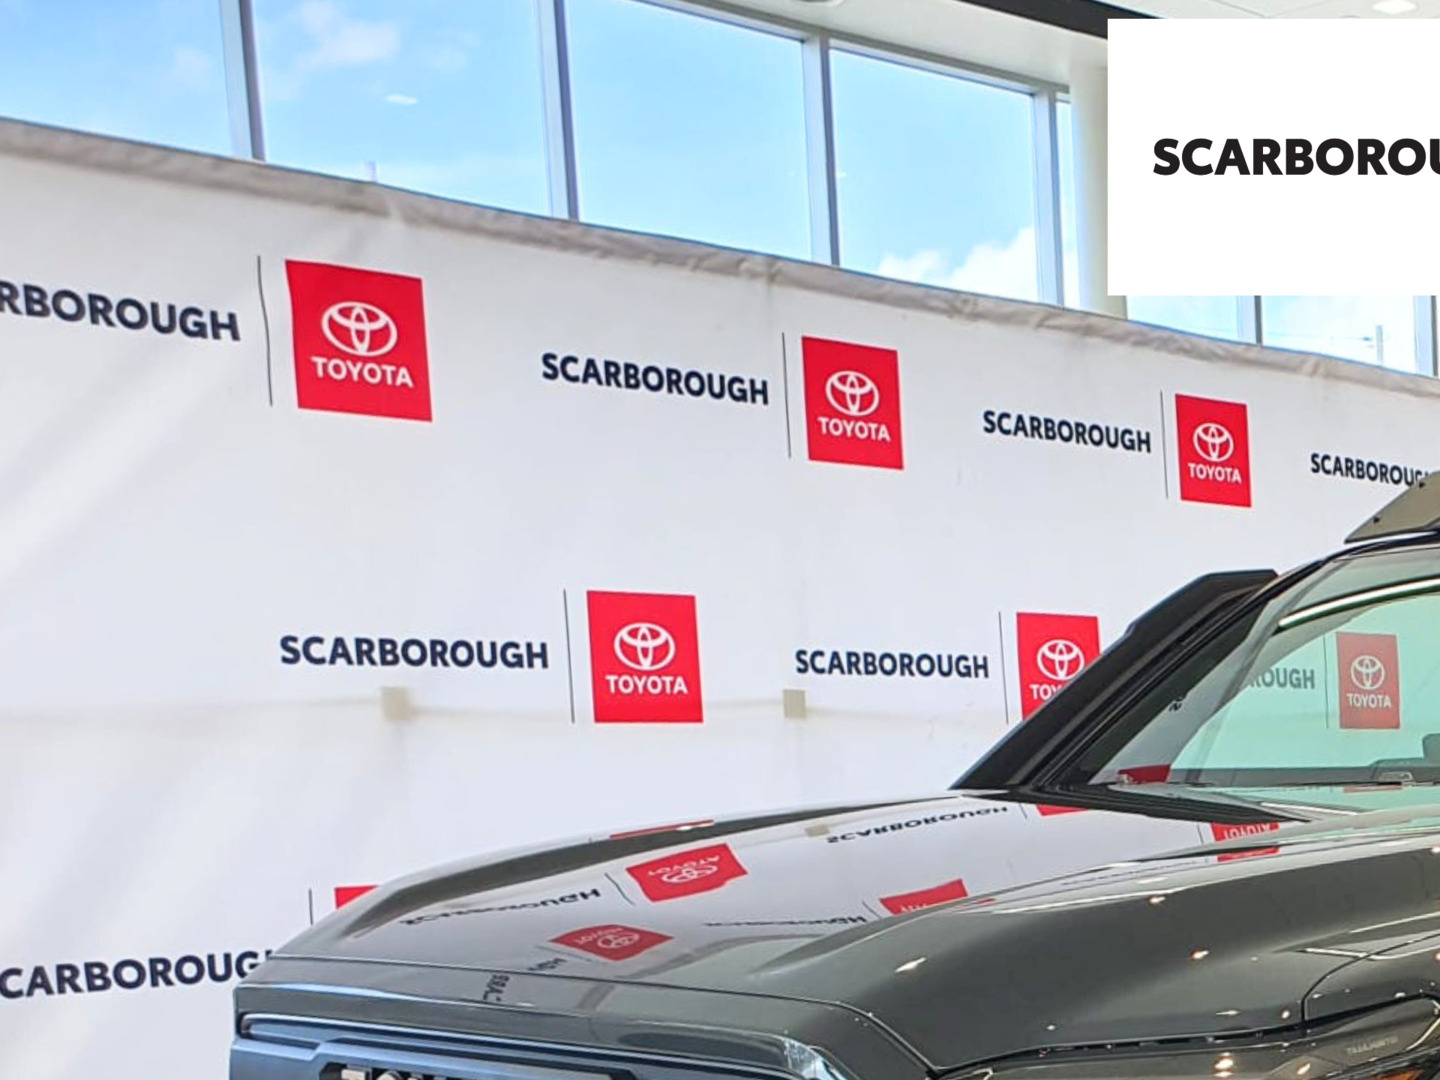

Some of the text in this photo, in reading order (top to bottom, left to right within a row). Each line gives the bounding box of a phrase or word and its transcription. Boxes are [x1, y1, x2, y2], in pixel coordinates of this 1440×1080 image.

[311, 355, 414, 389] TOYOTA
[542, 352, 769, 406] SCARBOROUGH
[818, 416, 891, 442] TOYOTA
[983, 410, 1151, 454] SCARBOROUGH
[1187, 462, 1242, 484] TOYOTA
[1311, 453, 1428, 487] SCARBOROU
[280, 635, 549, 669] SCARBOROUGH
[795, 649, 989, 679] SCARBOROUGH
[605, 674, 688, 695] TOYOTA
[1346, 692, 1392, 709] TOYOTA
[0, 949, 273, 999] CARBOROUG
